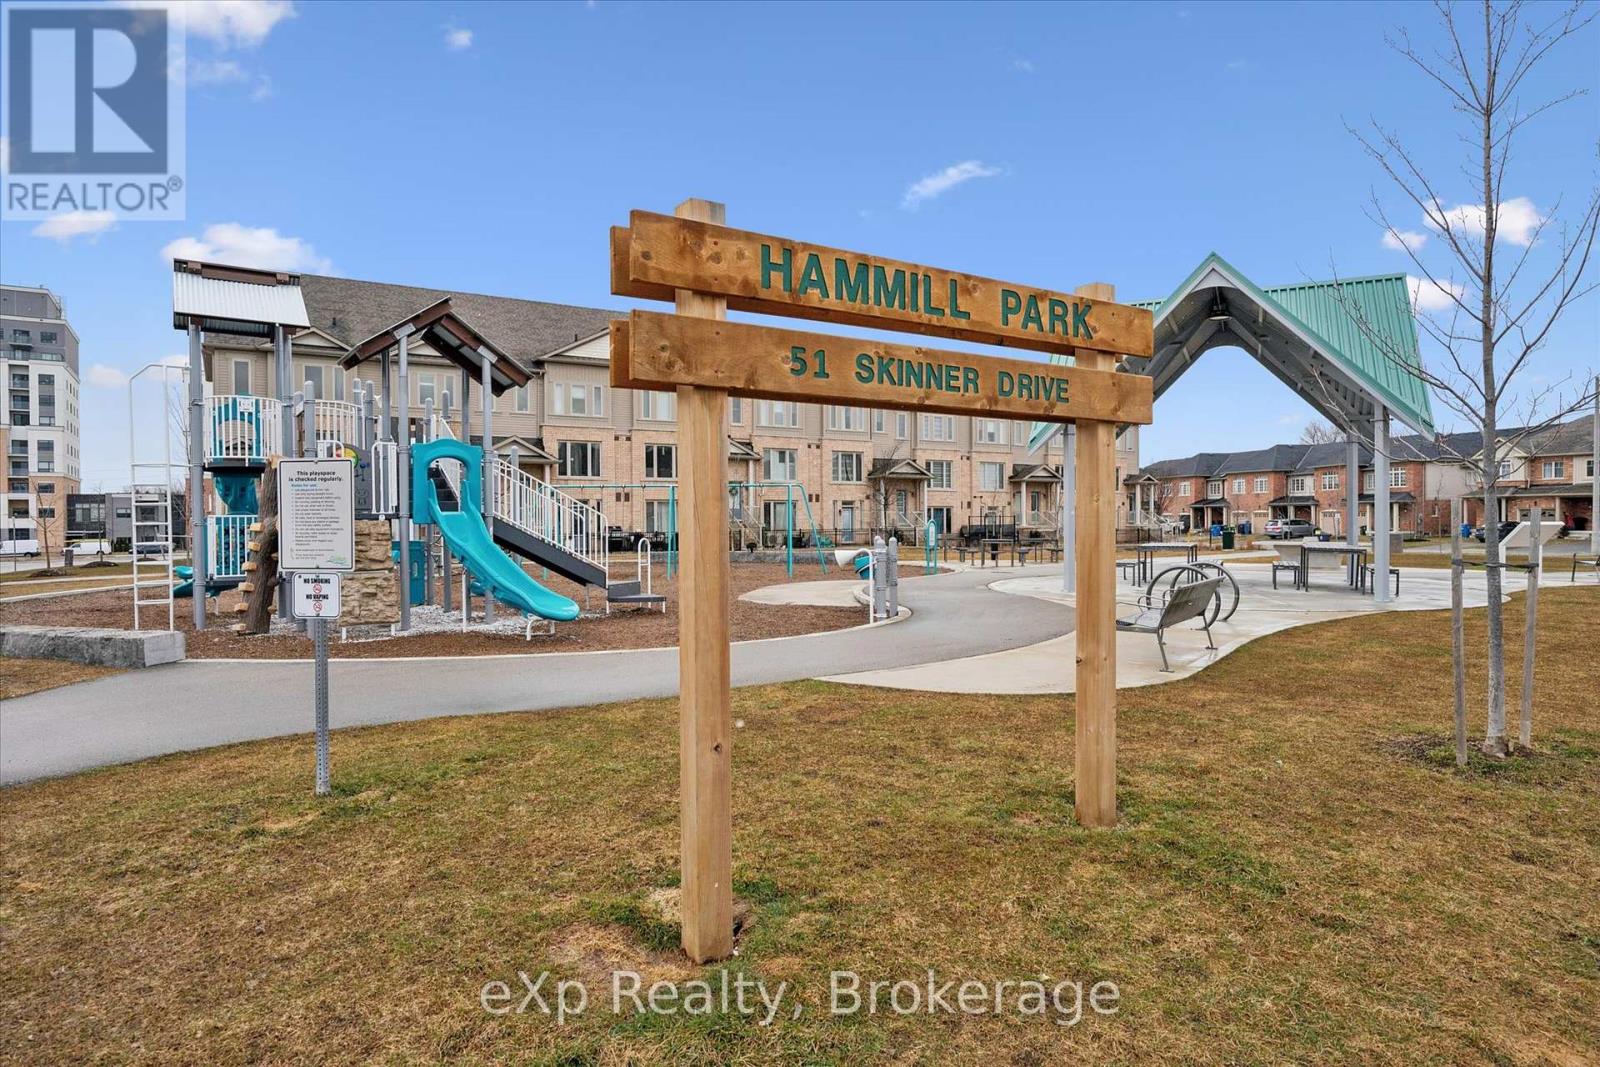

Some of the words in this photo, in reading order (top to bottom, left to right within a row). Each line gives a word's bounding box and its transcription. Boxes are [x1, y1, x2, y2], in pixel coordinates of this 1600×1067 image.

[760, 243, 971, 321] HAMMILL
[1001, 288, 1094, 341] PARK
[789, 345, 830, 380] 51
[855, 353, 980, 395] SKINNER
[997, 370, 1070, 404] DRIVE
